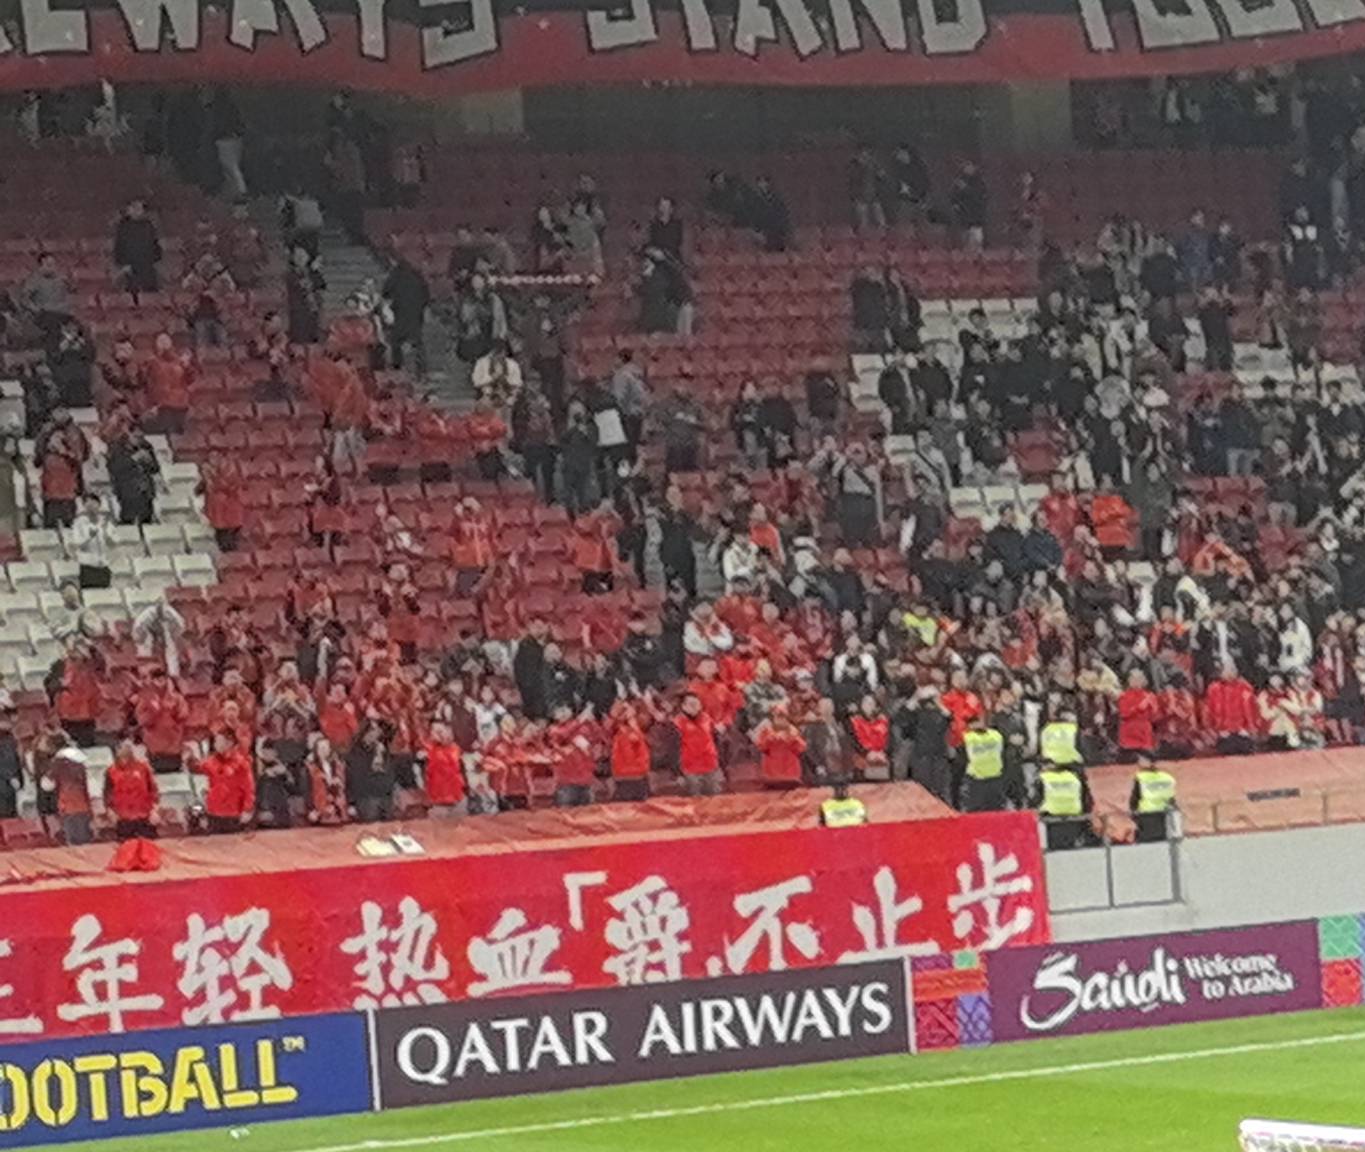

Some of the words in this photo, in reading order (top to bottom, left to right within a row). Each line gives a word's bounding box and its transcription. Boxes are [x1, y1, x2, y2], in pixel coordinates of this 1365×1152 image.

[1183, 952, 1279, 981] Welcome
[1202, 978, 1225, 1000] to
[1228, 970, 1294, 998] Arabia
[398, 1009, 615, 1086] QATAR
[638, 981, 893, 1058] AIRWAYS
